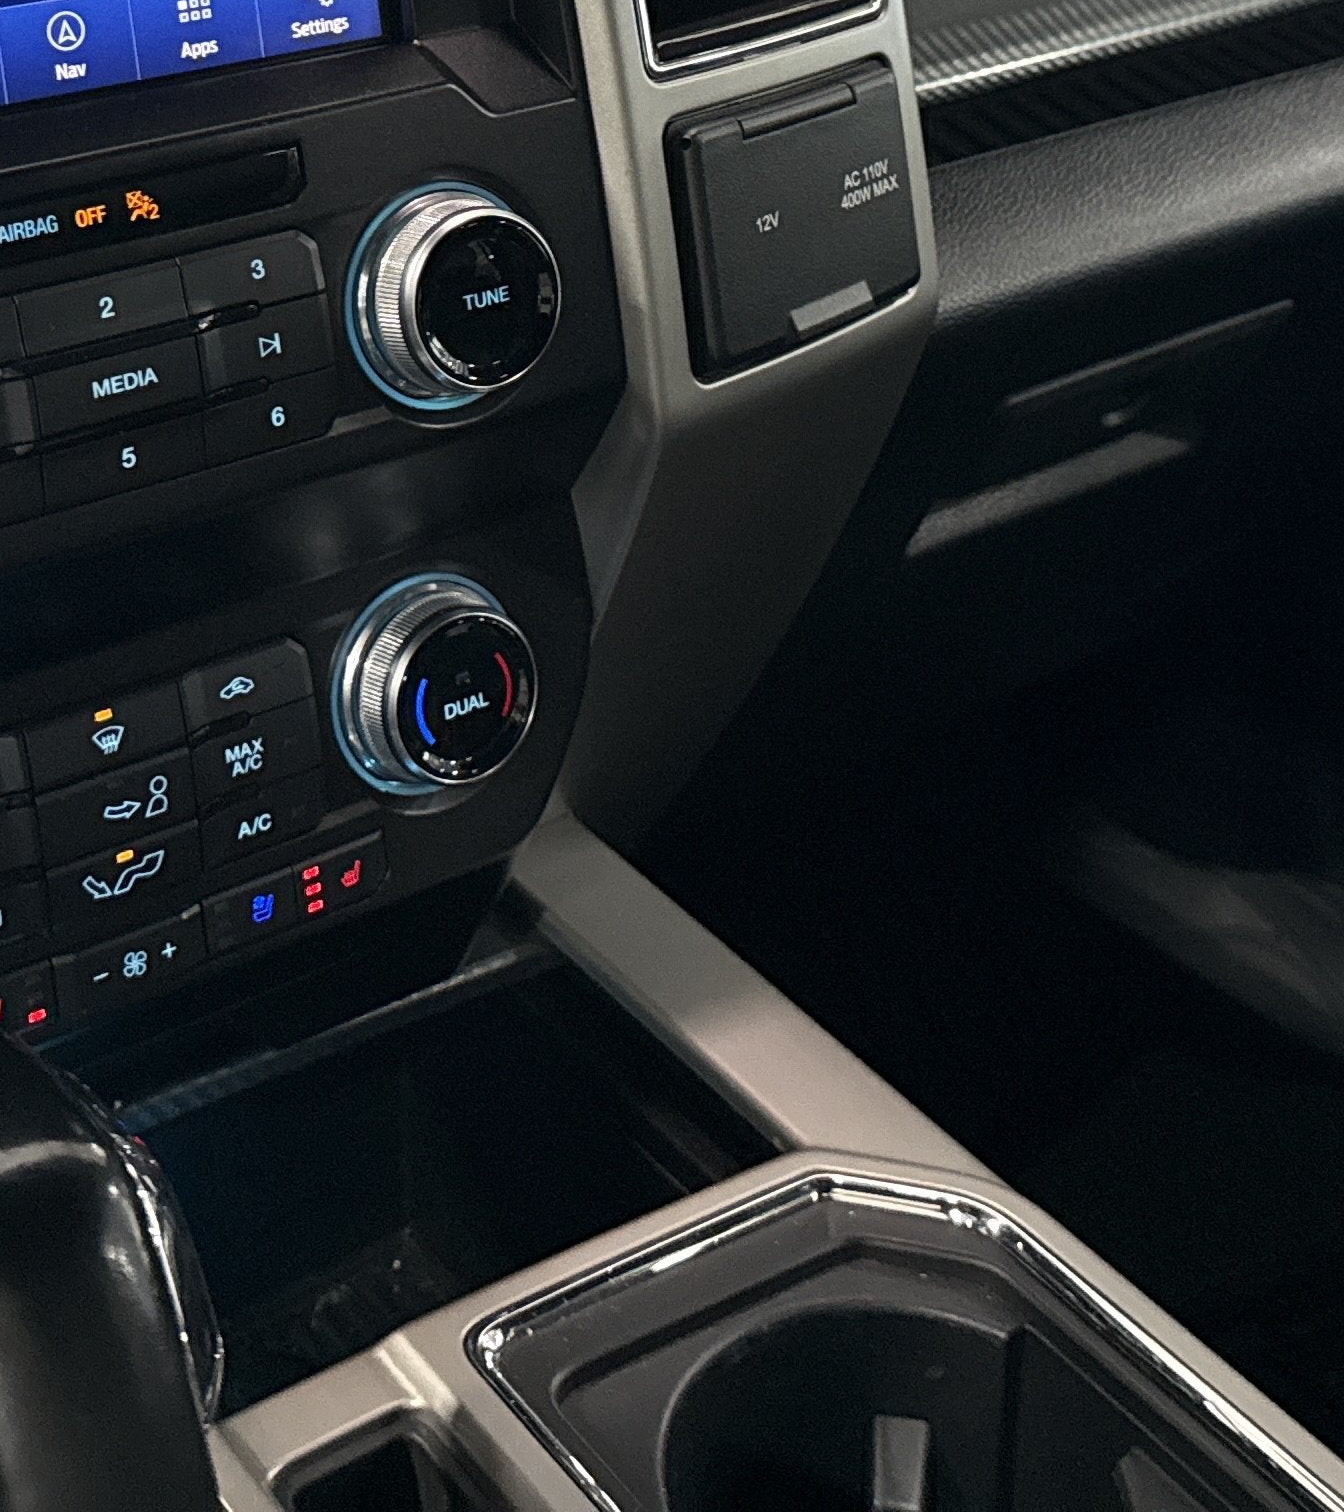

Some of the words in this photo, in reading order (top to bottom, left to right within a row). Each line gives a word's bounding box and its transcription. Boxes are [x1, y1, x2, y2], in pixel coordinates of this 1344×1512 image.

[290, 14, 350, 40] Settings
[179, 38, 219, 60] Apps
[54, 61, 87, 82] Nav
[843, 171, 861, 191] AC
[862, 158, 890, 183] 110V
[840, 188, 872, 211] 400W
[872, 173, 900, 198] MAX
[74, 204, 108, 228] OFF
[755, 210, 780, 233] 12V
[249, 258, 266, 280] 3
[98, 296, 116, 319] 2
[462, 285, 511, 311] TUNE
[91, 367, 159, 399] MEDIA
[270, 406, 286, 427] 6
[121, 446, 137, 469] 5
[443, 691, 490, 720] DUAL
[224, 737, 265, 764] MAX
[230, 752, 264, 778] A/C
[237, 812, 273, 840] A/C
